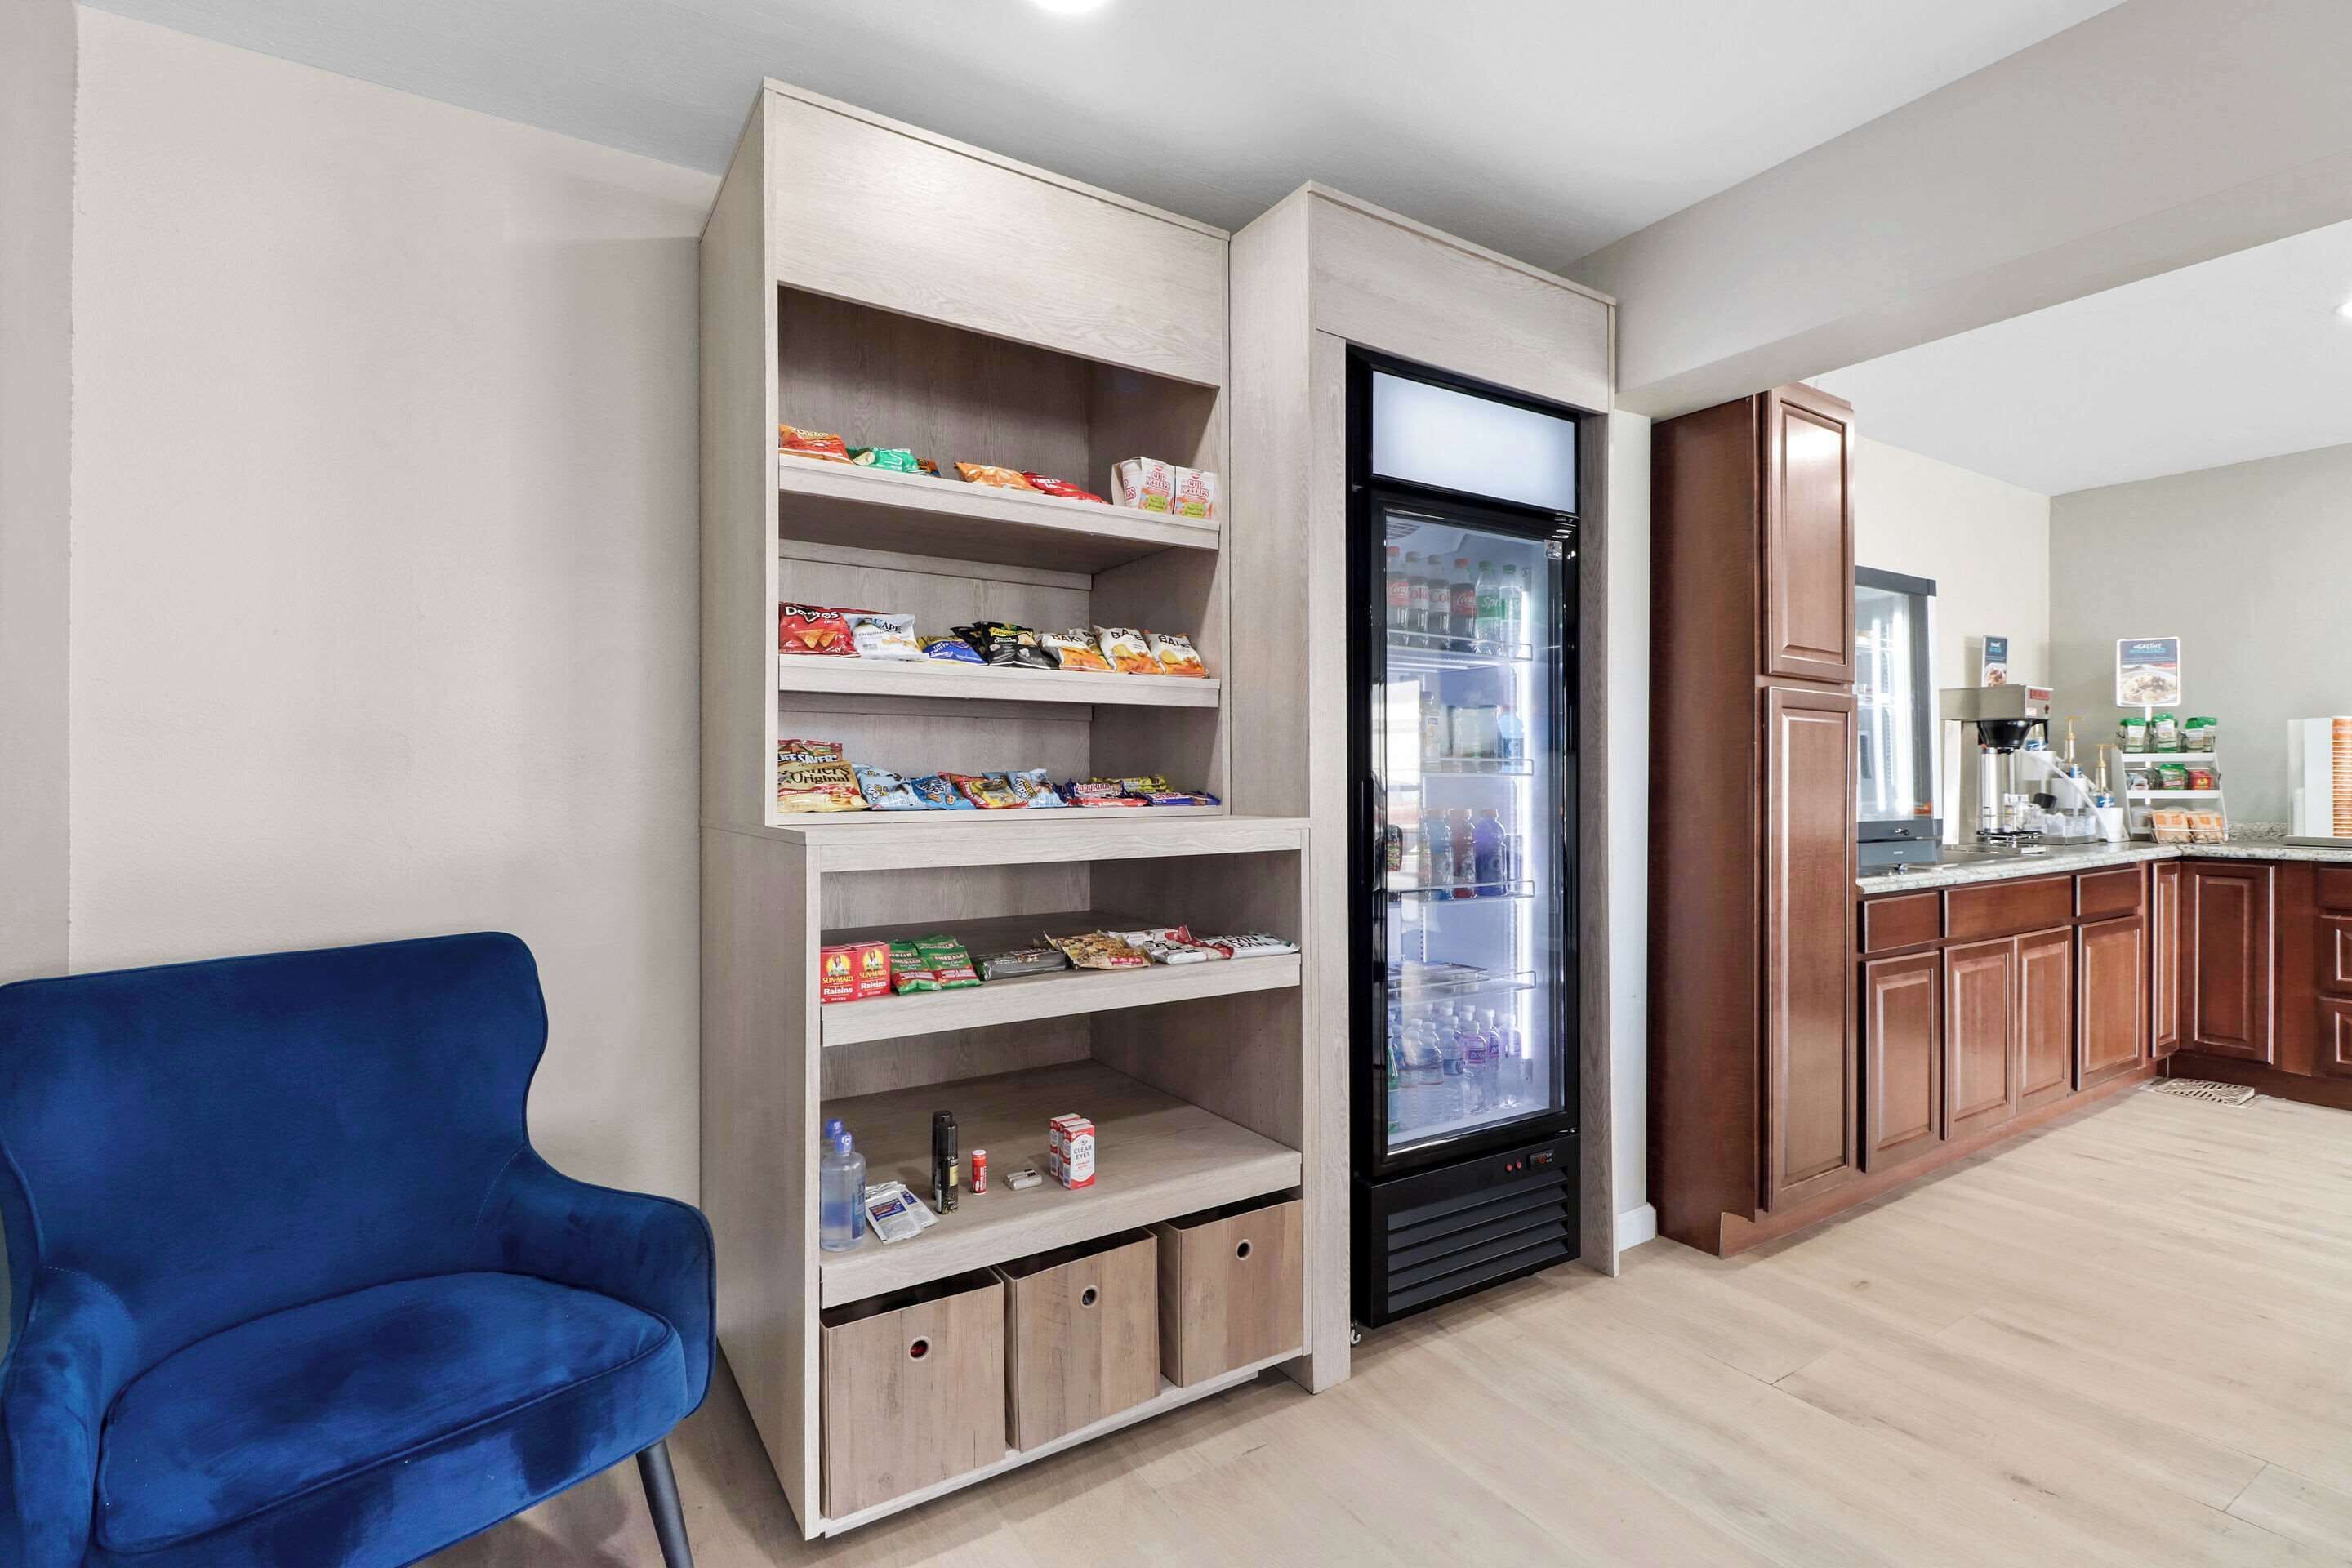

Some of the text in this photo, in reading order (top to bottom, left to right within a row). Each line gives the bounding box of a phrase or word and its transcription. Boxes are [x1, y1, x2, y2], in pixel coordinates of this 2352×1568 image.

[1152, 471, 1167, 481] CUP
[1146, 476, 1170, 491] NOODLES
[1188, 479, 1205, 488] CUP
[1181, 485, 1209, 497] NOODLES
[786, 606, 839, 619] Doritos
[874, 618, 902, 633] CAPE
[791, 772, 850, 784] Original
[859, 969, 887, 978] SUN-MAID
[861, 981, 886, 989] Raisins
[1073, 1145, 1092, 1154] CLEAR
